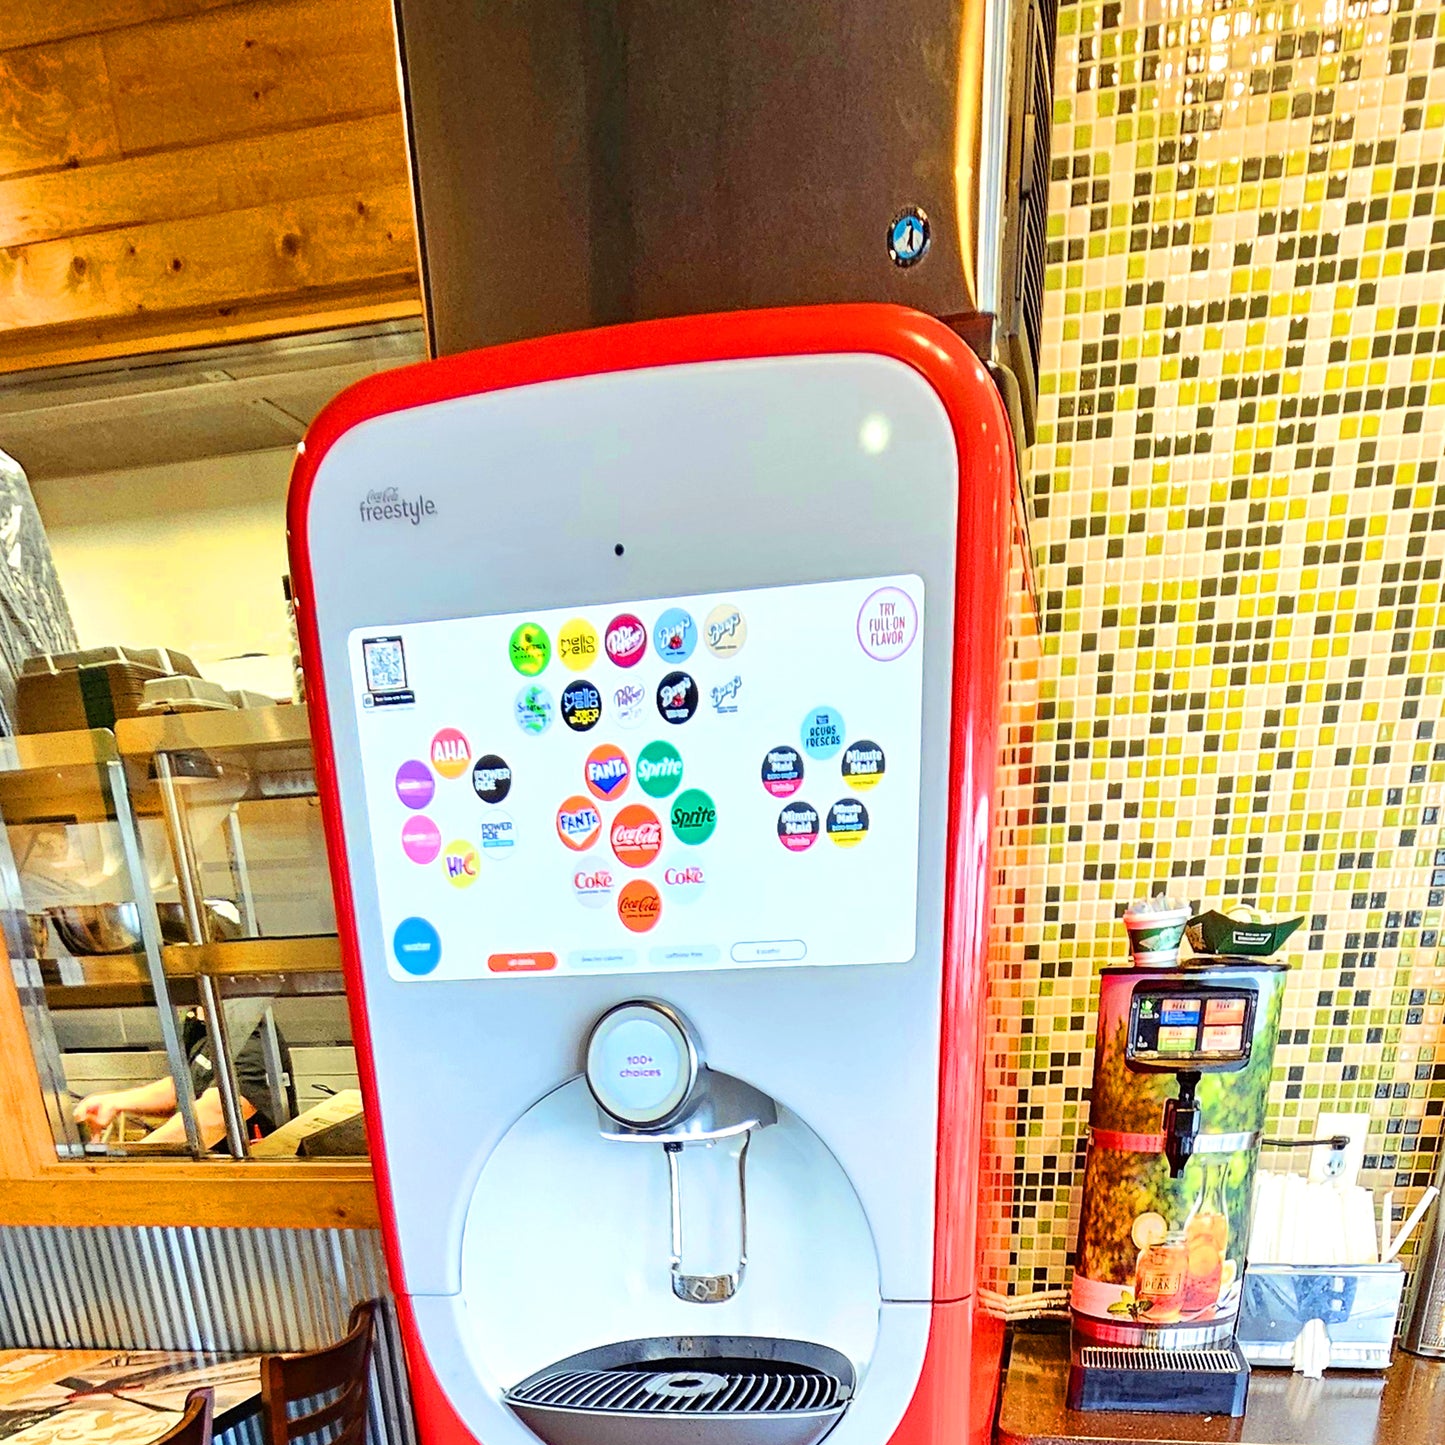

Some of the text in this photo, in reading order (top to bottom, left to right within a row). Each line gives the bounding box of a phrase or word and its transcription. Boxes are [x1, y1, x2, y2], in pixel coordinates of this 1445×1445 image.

[360, 494, 435, 525] freestyle
[879, 602, 896, 616] TRY
[869, 616, 906, 632] FULL-ON
[871, 630, 904, 646] FLAVOR
[434, 738, 469, 761] AHA
[846, 750, 882, 763] Minute
[638, 757, 682, 782] Sprite
[850, 760, 877, 774] Maid
[474, 768, 510, 781] POWER
[671, 806, 715, 829] Sprite
[781, 810, 817, 823] Minute
[481, 822, 513, 831] POWER
[785, 822, 812, 834] Maid
[574, 871, 614, 890] Coke
[664, 867, 706, 886] Coke
[627, 1055, 653, 1065] 100+
[619, 1068, 661, 1078] choices
